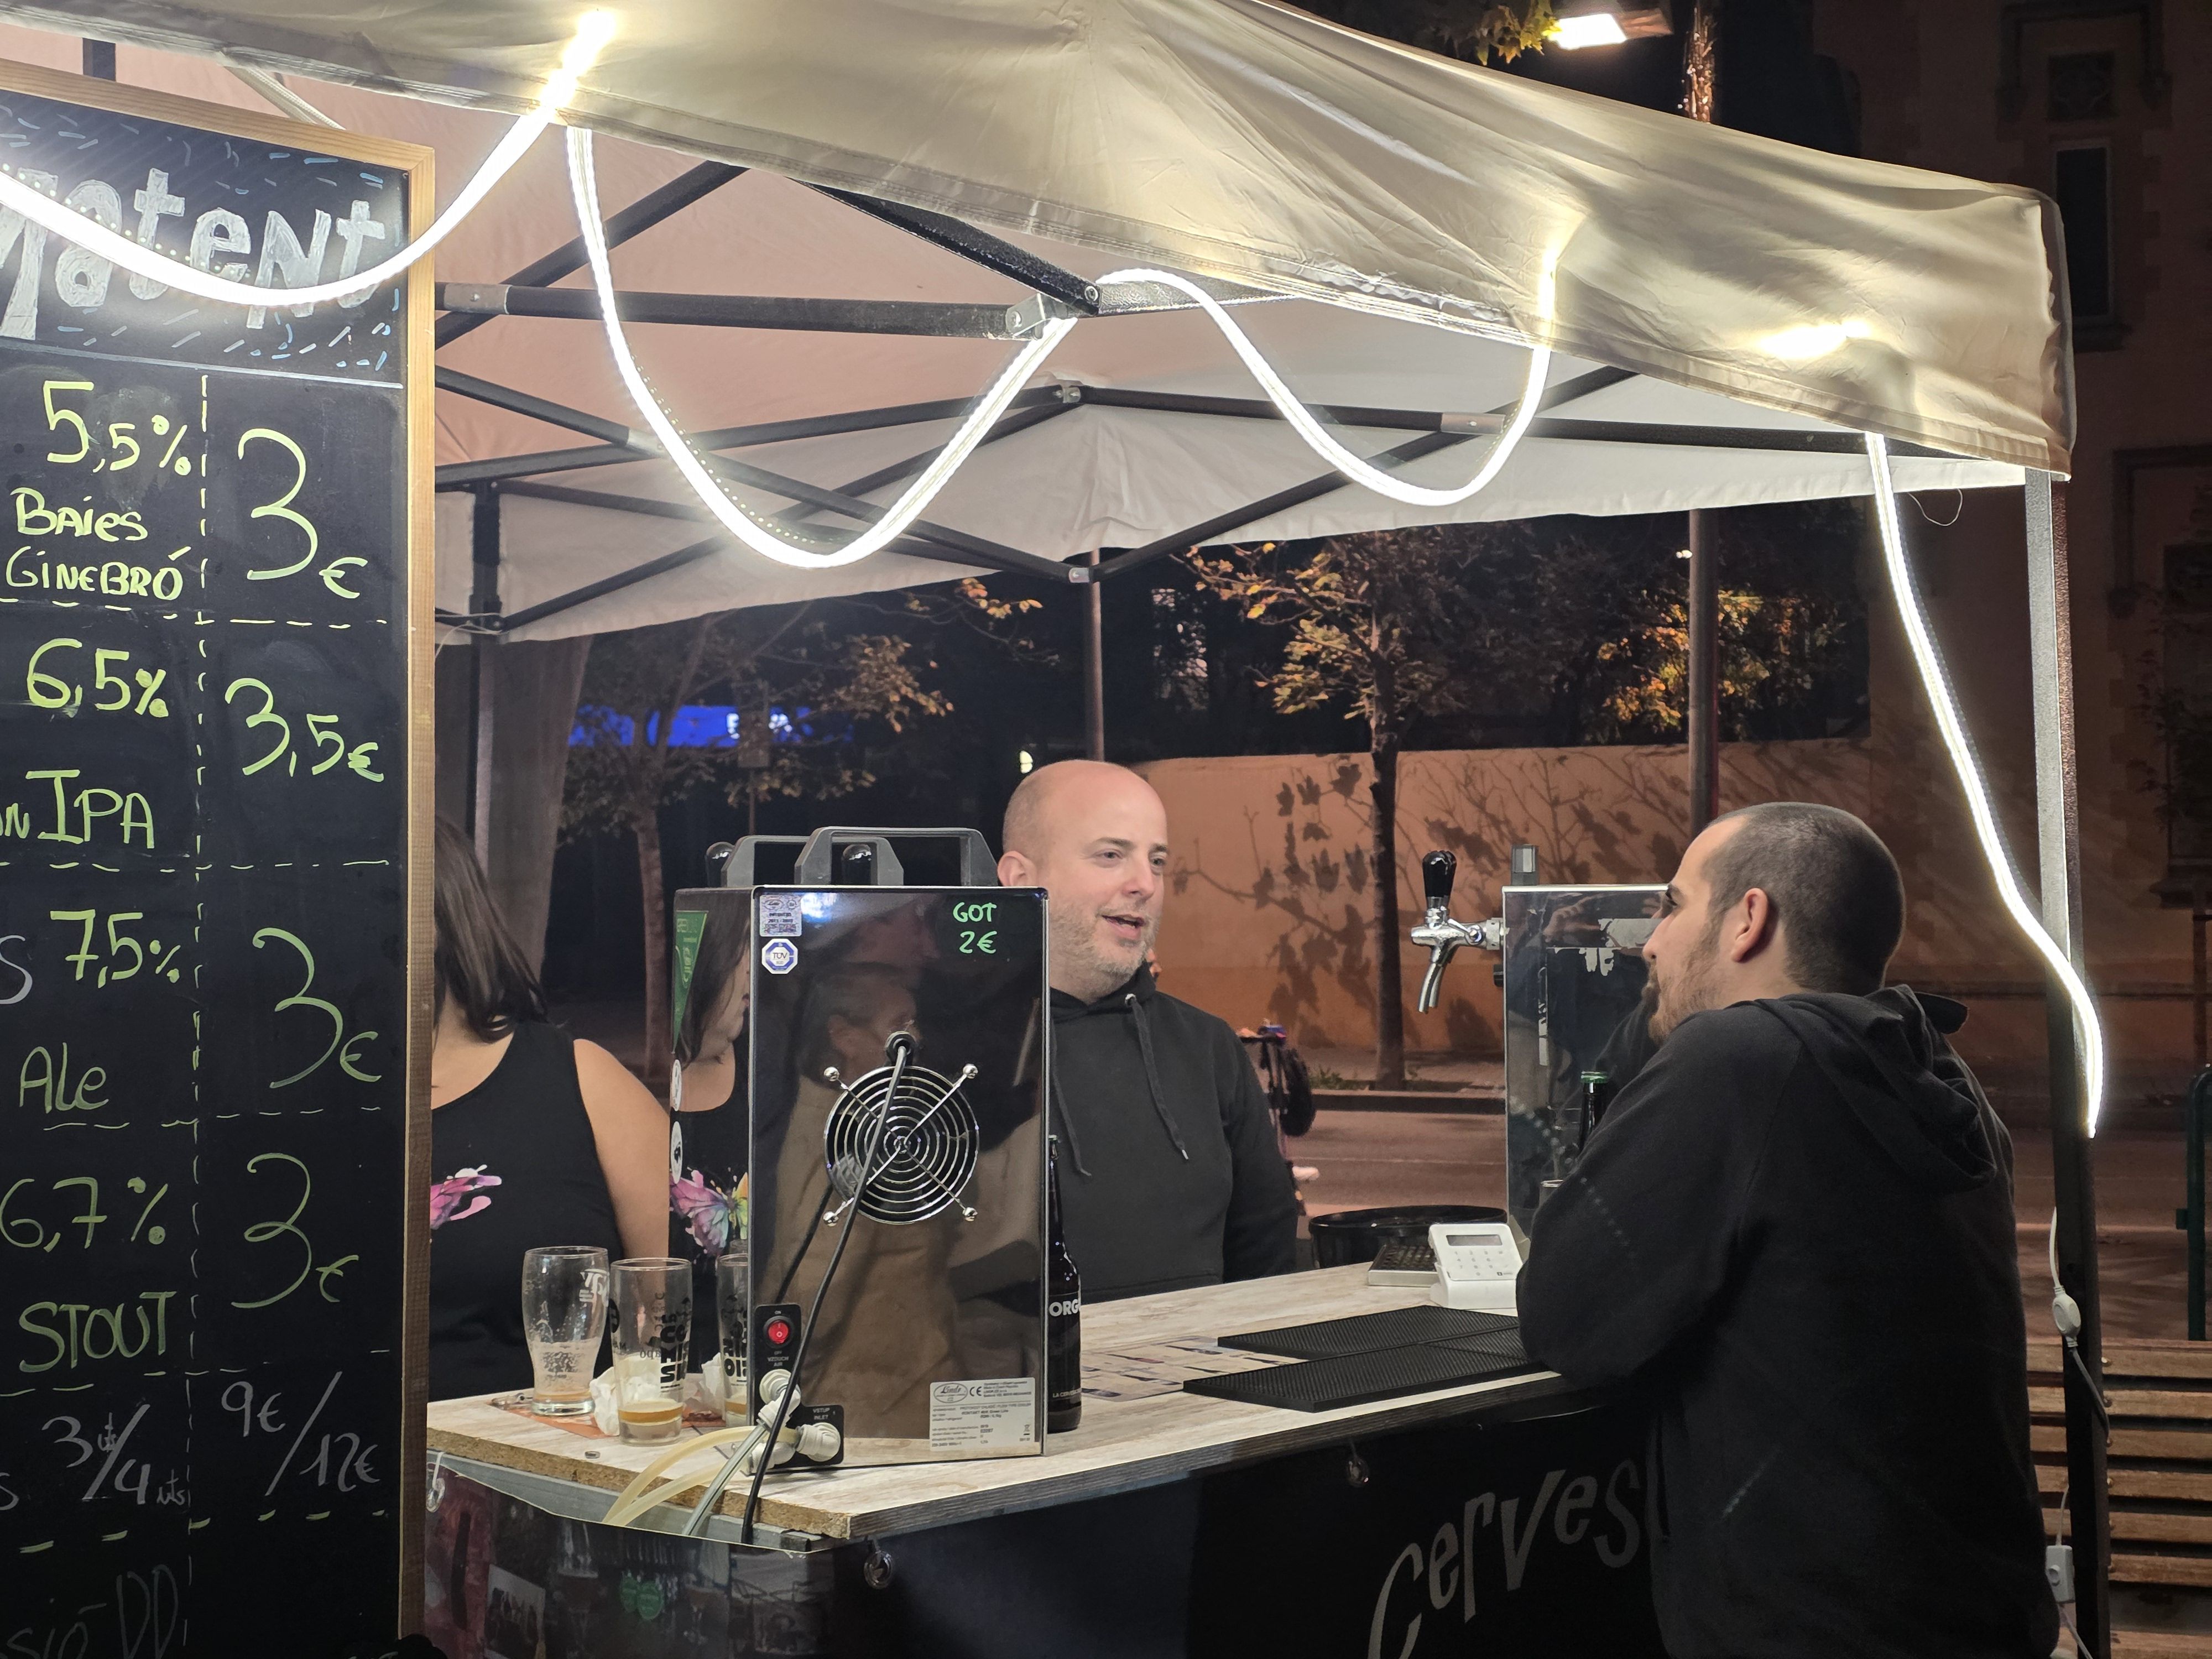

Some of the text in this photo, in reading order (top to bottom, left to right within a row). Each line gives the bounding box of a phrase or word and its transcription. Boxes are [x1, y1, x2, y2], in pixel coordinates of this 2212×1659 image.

[43, 380, 191, 476] 5,5%
[238, 427, 368, 599] 3€
[27, 638, 169, 718] 6,5%
[225, 677, 384, 782] 3,5€
[25, 769, 155, 848] IPA
[50, 909, 181, 989] 7,5%
[953, 901, 997, 922] GOT
[959, 930, 998, 954] 2€
[252, 927, 382, 1089] 3€
[19, 1042, 109, 1114] Ale
[0, 1176, 168, 1253] 6,7%
[231, 1152, 359, 1309] 3€
[19, 1291, 178, 1373] STOUT
